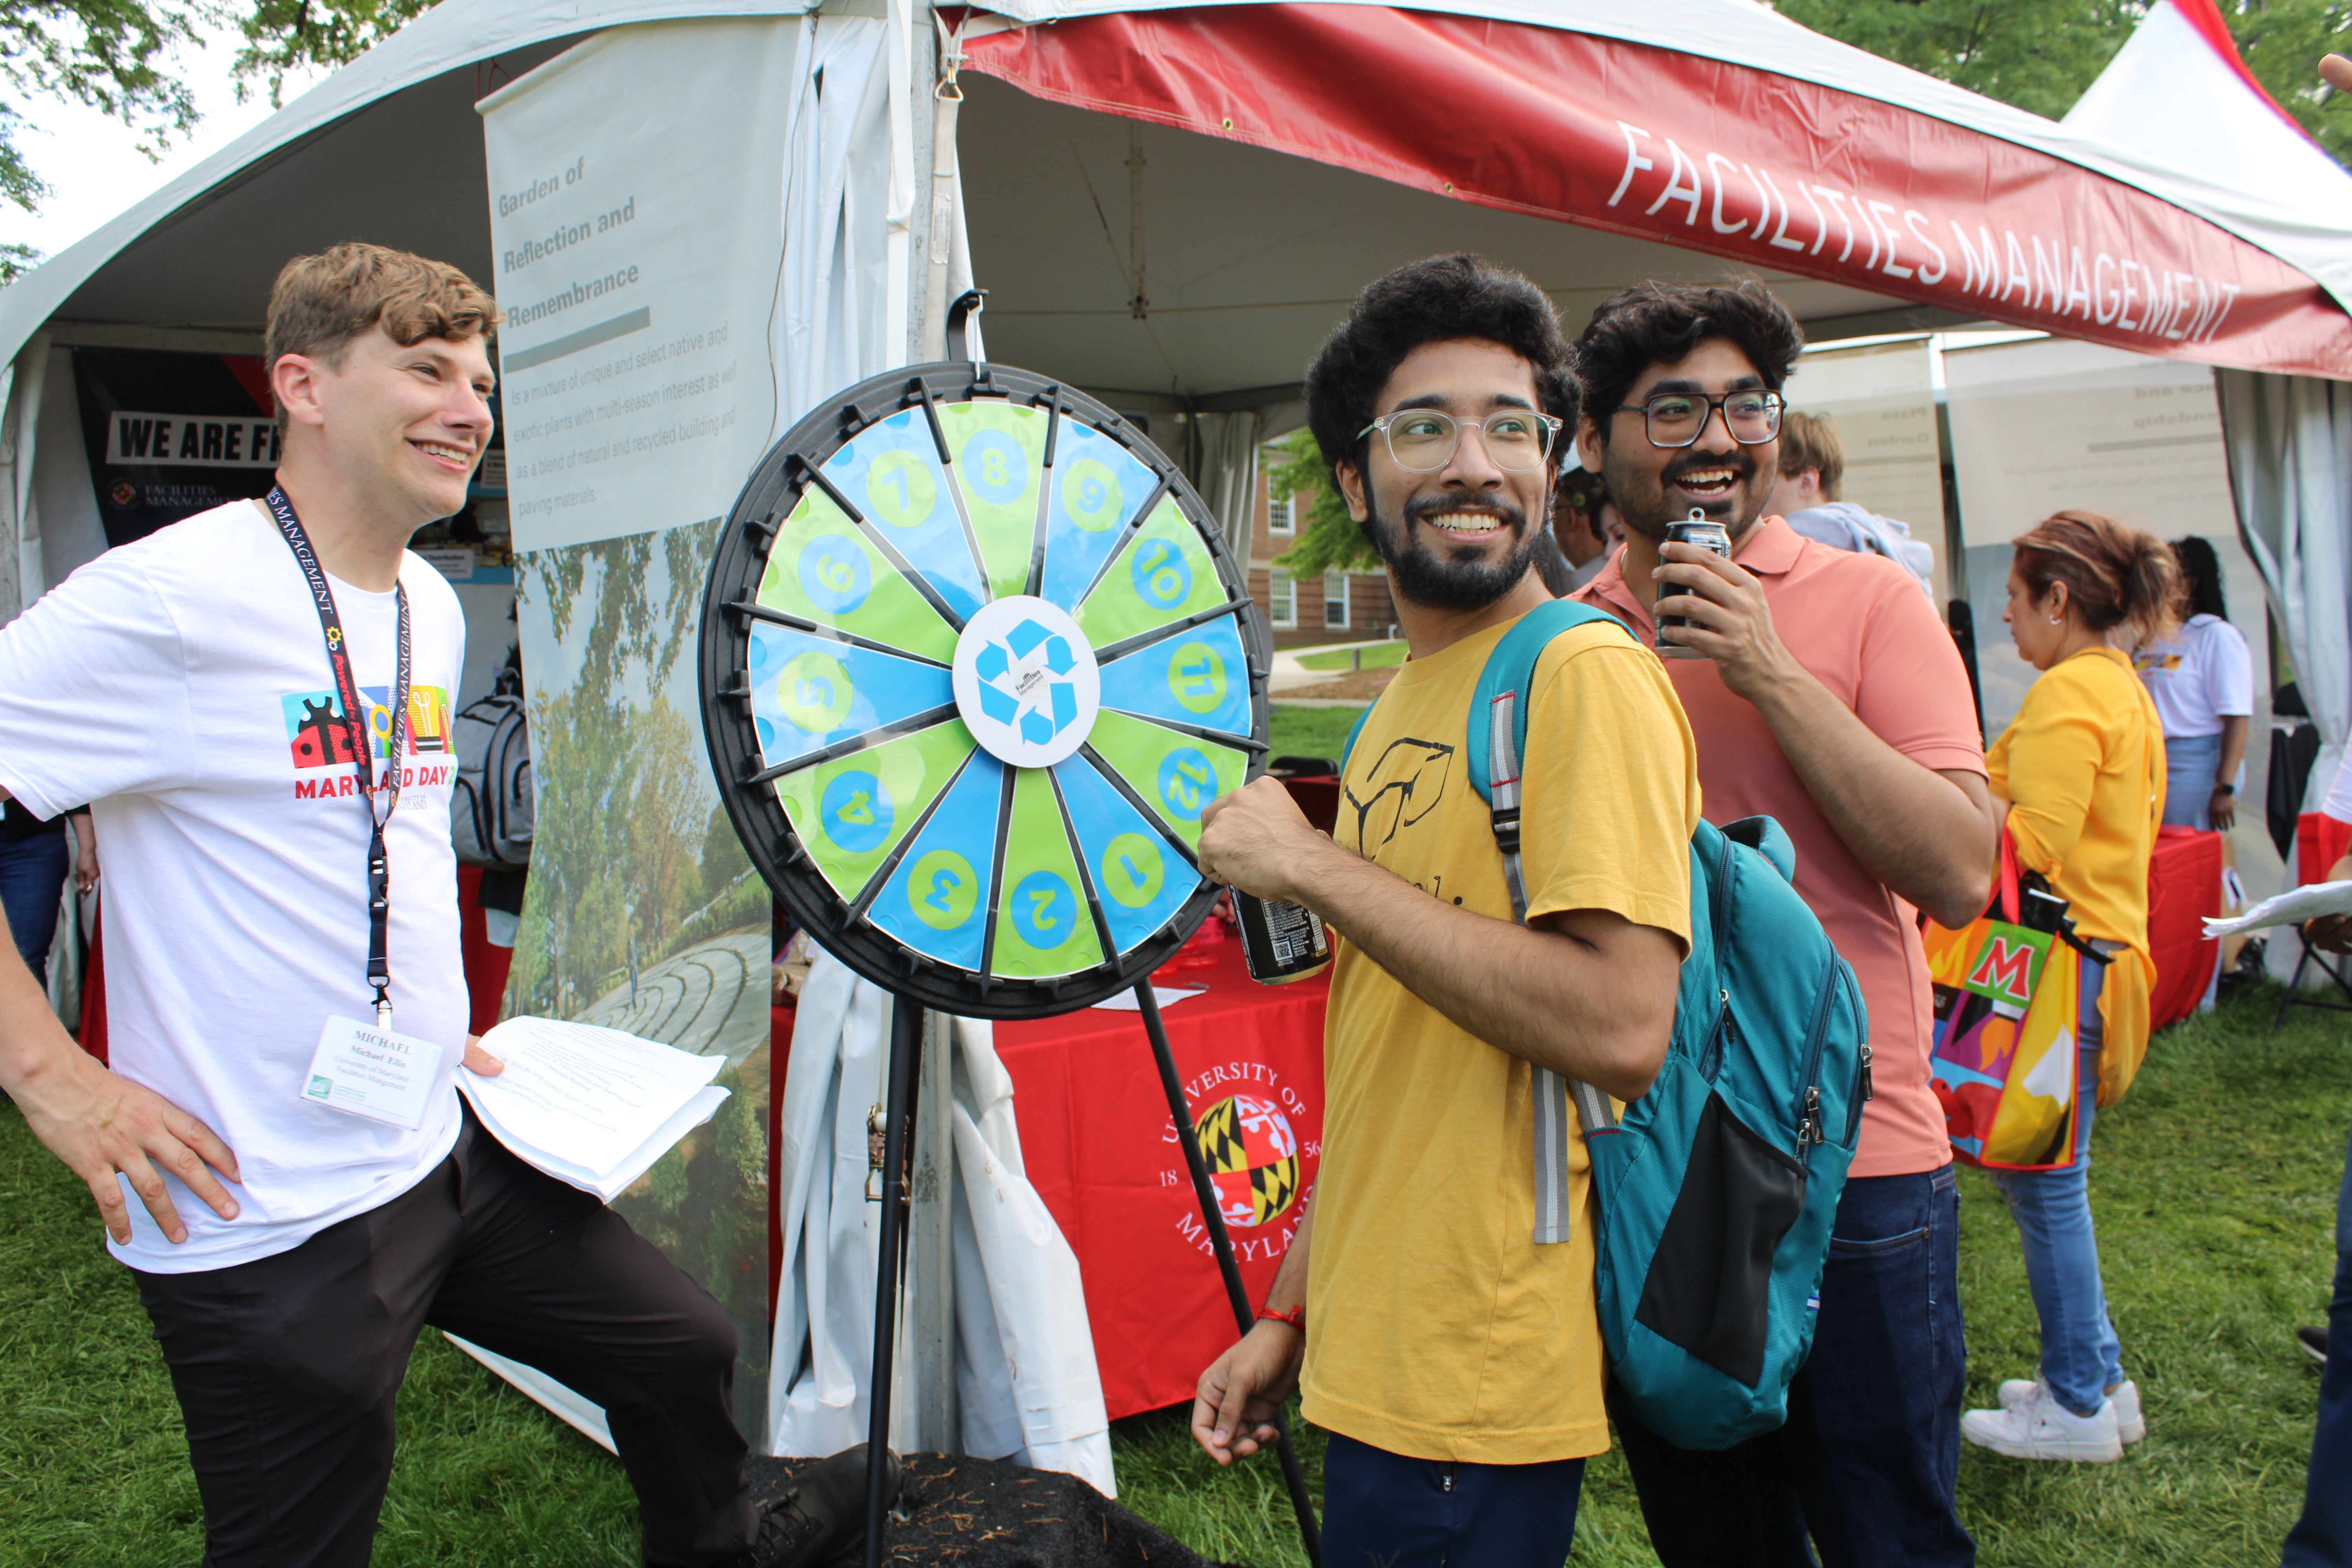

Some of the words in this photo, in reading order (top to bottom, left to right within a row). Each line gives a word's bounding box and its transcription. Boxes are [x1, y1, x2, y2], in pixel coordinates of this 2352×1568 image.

[499, 175, 559, 218] Garden
[566, 155, 584, 185] of
[504, 221, 592, 273] Reflection
[598, 196, 634, 233] and
[1607, 120, 1947, 285] FACILITIES
[1949, 220, 2241, 344] MANAGEMENT
[508, 264, 639, 328] Remembrance
[512, 388, 521, 406] Is
[523, 390, 529, 403] a
[532, 379, 566, 401] mixture
[569, 370, 578, 390] of
[580, 363, 612, 386] unique
[615, 352, 633, 375] and
[636, 344, 666, 368] select
[669, 333, 704, 358] native
[708, 320, 728, 347] and
[514, 421, 543, 443] exotic
[545, 415, 573, 438] plants
[575, 406, 595, 427] with
[597, 390, 659, 422] multi-season
[662, 375, 704, 402] interest
[708, 373, 719, 390] as
[721, 359, 737, 385] well
[120, 418, 172, 457] WE
[179, 422, 243, 460] ARE
[516, 465, 528, 479] as
[531, 463, 536, 476] a
[539, 452, 564, 475] blend
[567, 449, 577, 468] of
[578, 441, 610, 465] natural
[613, 436, 630, 457] and
[633, 423, 677, 453] recycled
[679, 415, 720, 441] building
[721, 403, 735, 428] and
[881, 466, 910, 511] 7
[982, 448, 1010, 487] 8
[145, 485, 216, 495] FACILITIES
[518, 495, 552, 519] paving
[554, 486, 597, 509] materials.
[1077, 477, 1106, 513] 9
[275, 506, 333, 614] MANAGEMENT
[816, 554, 855, 593] 6
[1140, 543, 1182, 600] 10
[401, 591, 410, 703] MANAGEMENT
[333, 653, 356, 712] Powered
[796, 676, 834, 708] 5
[1181, 657, 1215, 697] 11
[349, 711, 355, 719] by
[349, 721, 367, 766] People
[392, 705, 407, 788] FACILITIES
[418, 766, 448, 786] DAY
[1168, 759, 1208, 810] 12
[837, 789, 875, 826] 4
[924, 869, 961, 913] 3
[1118, 853, 1148, 890] 1
[1029, 889, 1058, 930] 2
[1967, 936, 2035, 1001] M
[350, 1045, 385, 1061] Michael
[354, 1030, 411, 1055] MICHAEL
[1281, 1087, 1306, 1116] OF
[1160, 1169, 1178, 1187] 18
[1304, 1141, 1321, 1158] 56
